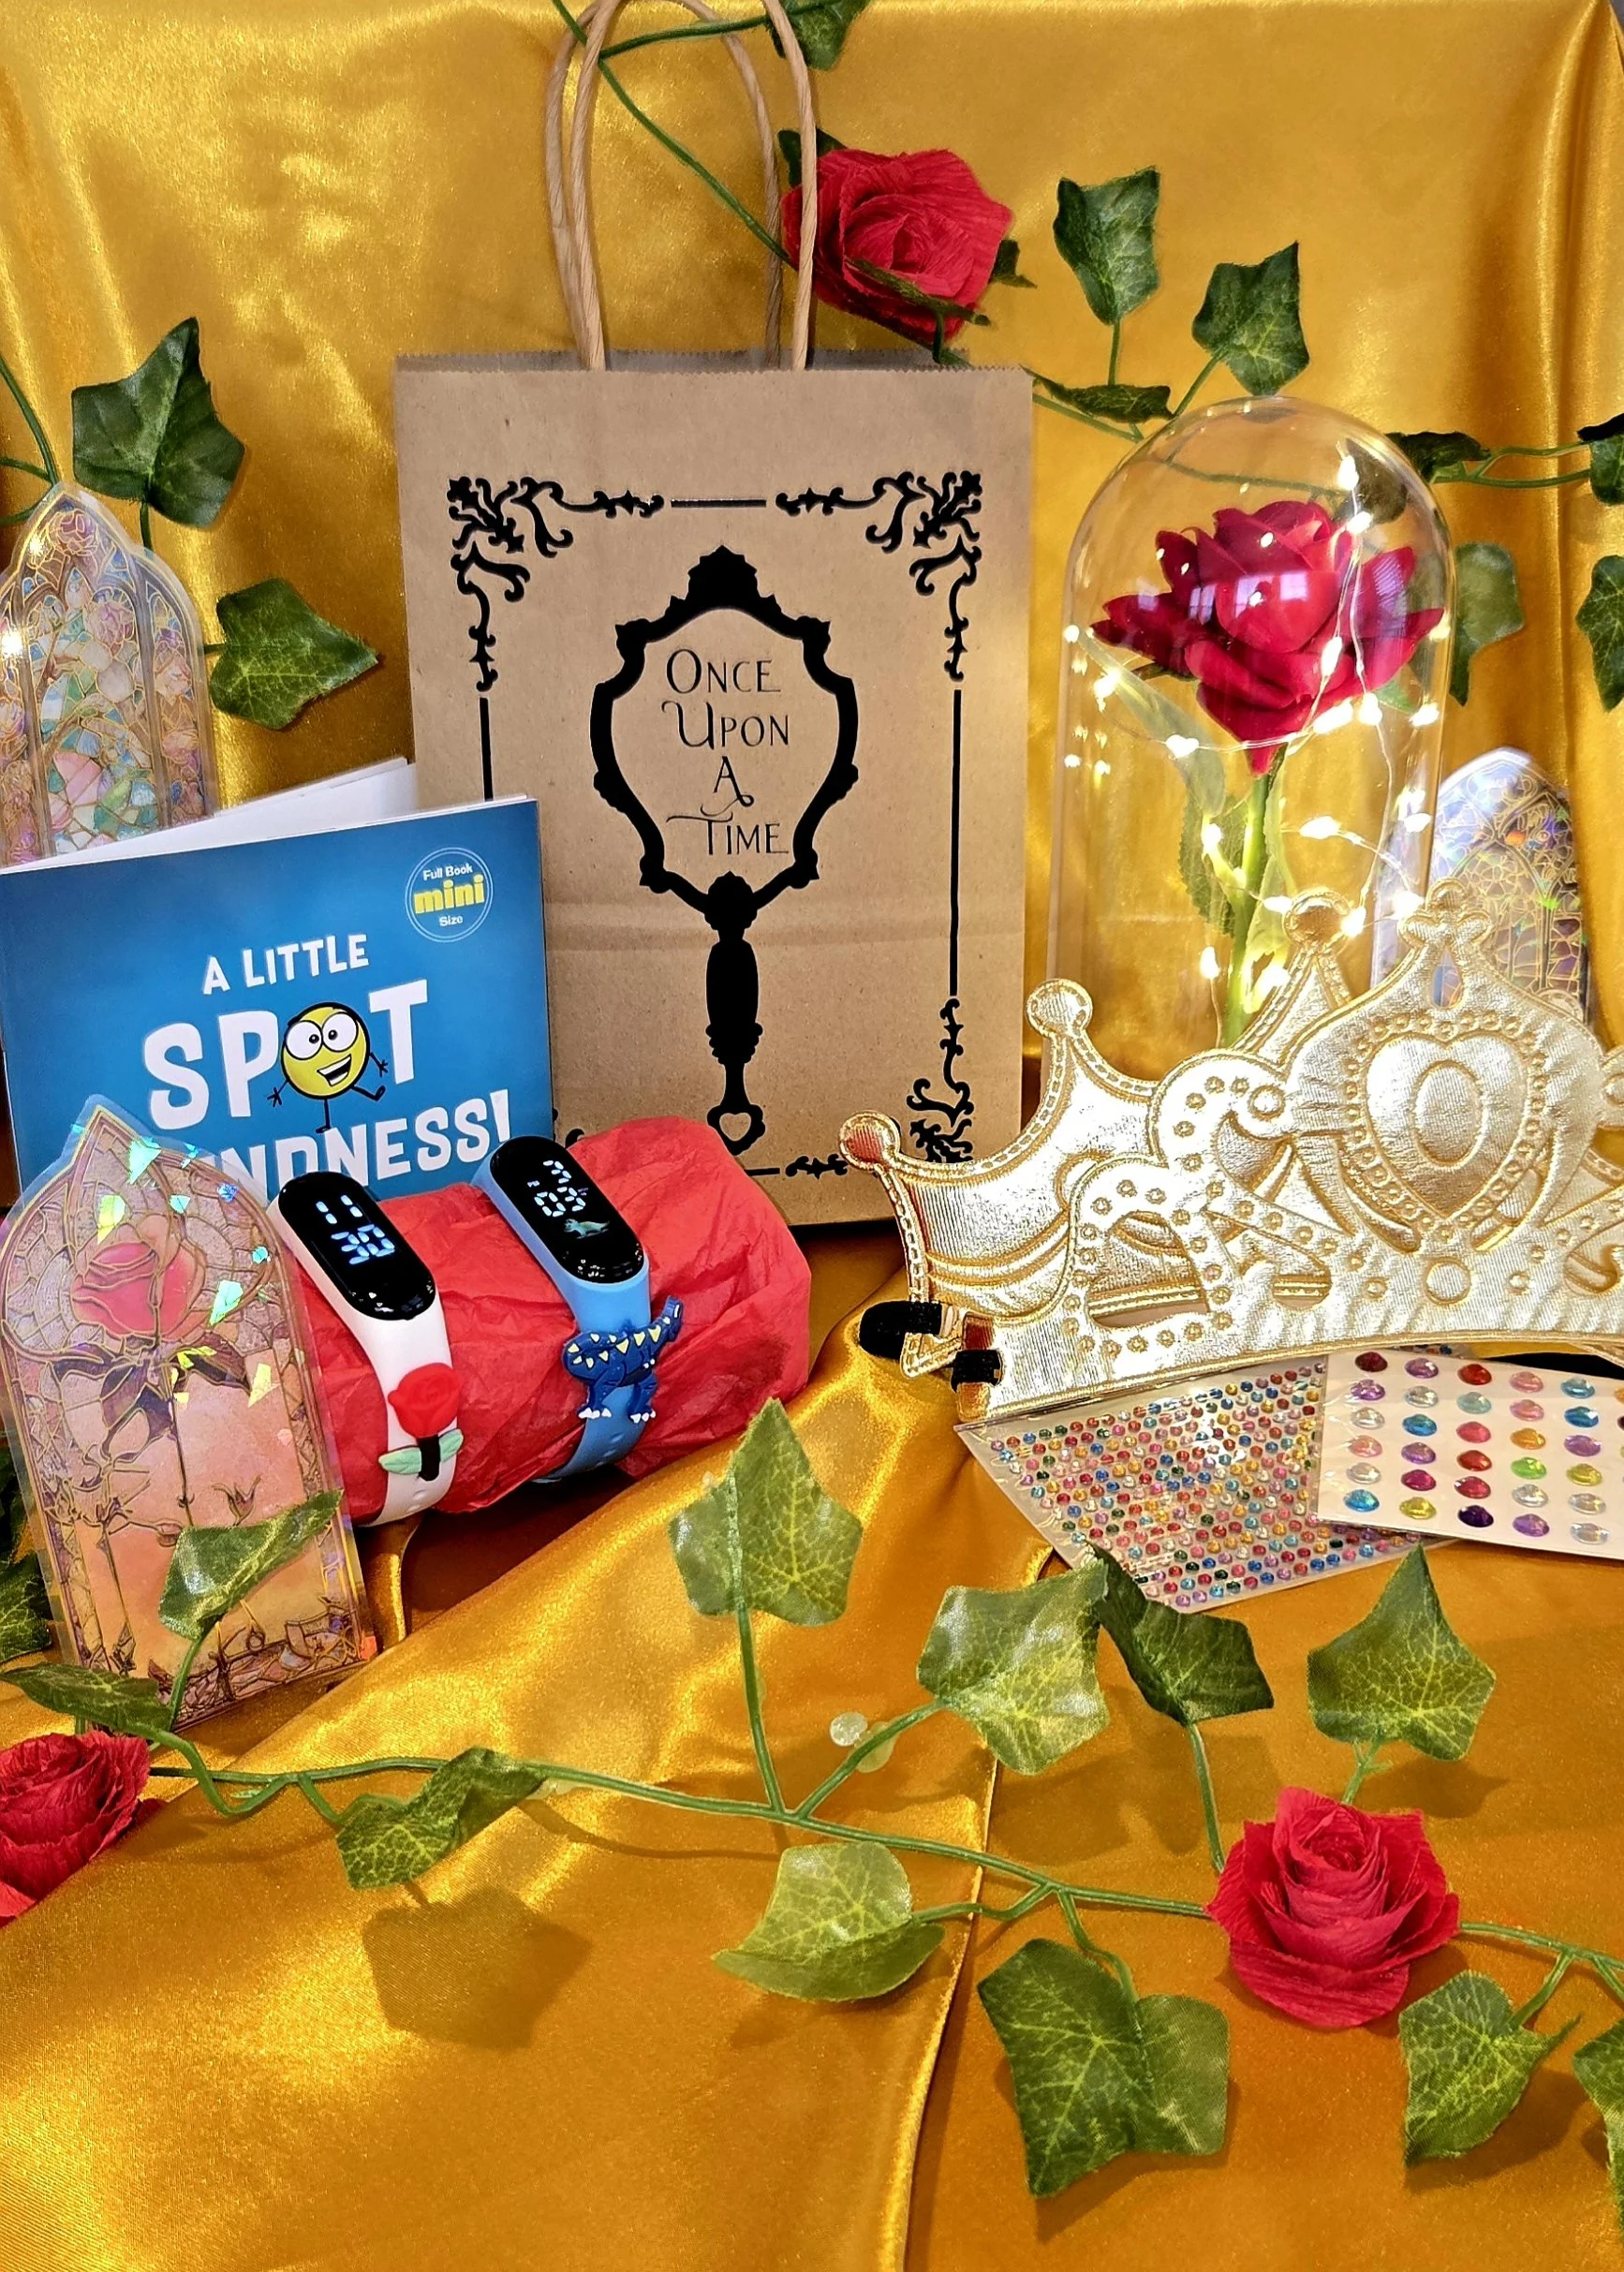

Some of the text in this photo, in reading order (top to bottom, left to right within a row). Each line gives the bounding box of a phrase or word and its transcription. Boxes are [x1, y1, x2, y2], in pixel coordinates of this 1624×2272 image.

[666, 648, 782, 694] ONCE
[661, 701, 790, 749] UPON
[701, 756, 754, 817] A
[666, 812, 790, 855] TIME
[423, 863, 473, 880] Full Book
[414, 874, 485, 914] mini
[439, 915, 464, 927] Size
[203, 934, 370, 996] A LITTLE
[197, 1089, 510, 1209] NDNESS!
[542, 1159, 572, 1184] 3
[316, 1194, 363, 1224] 11
[534, 1187, 586, 1217] 03
[331, 1223, 395, 1265] 30
